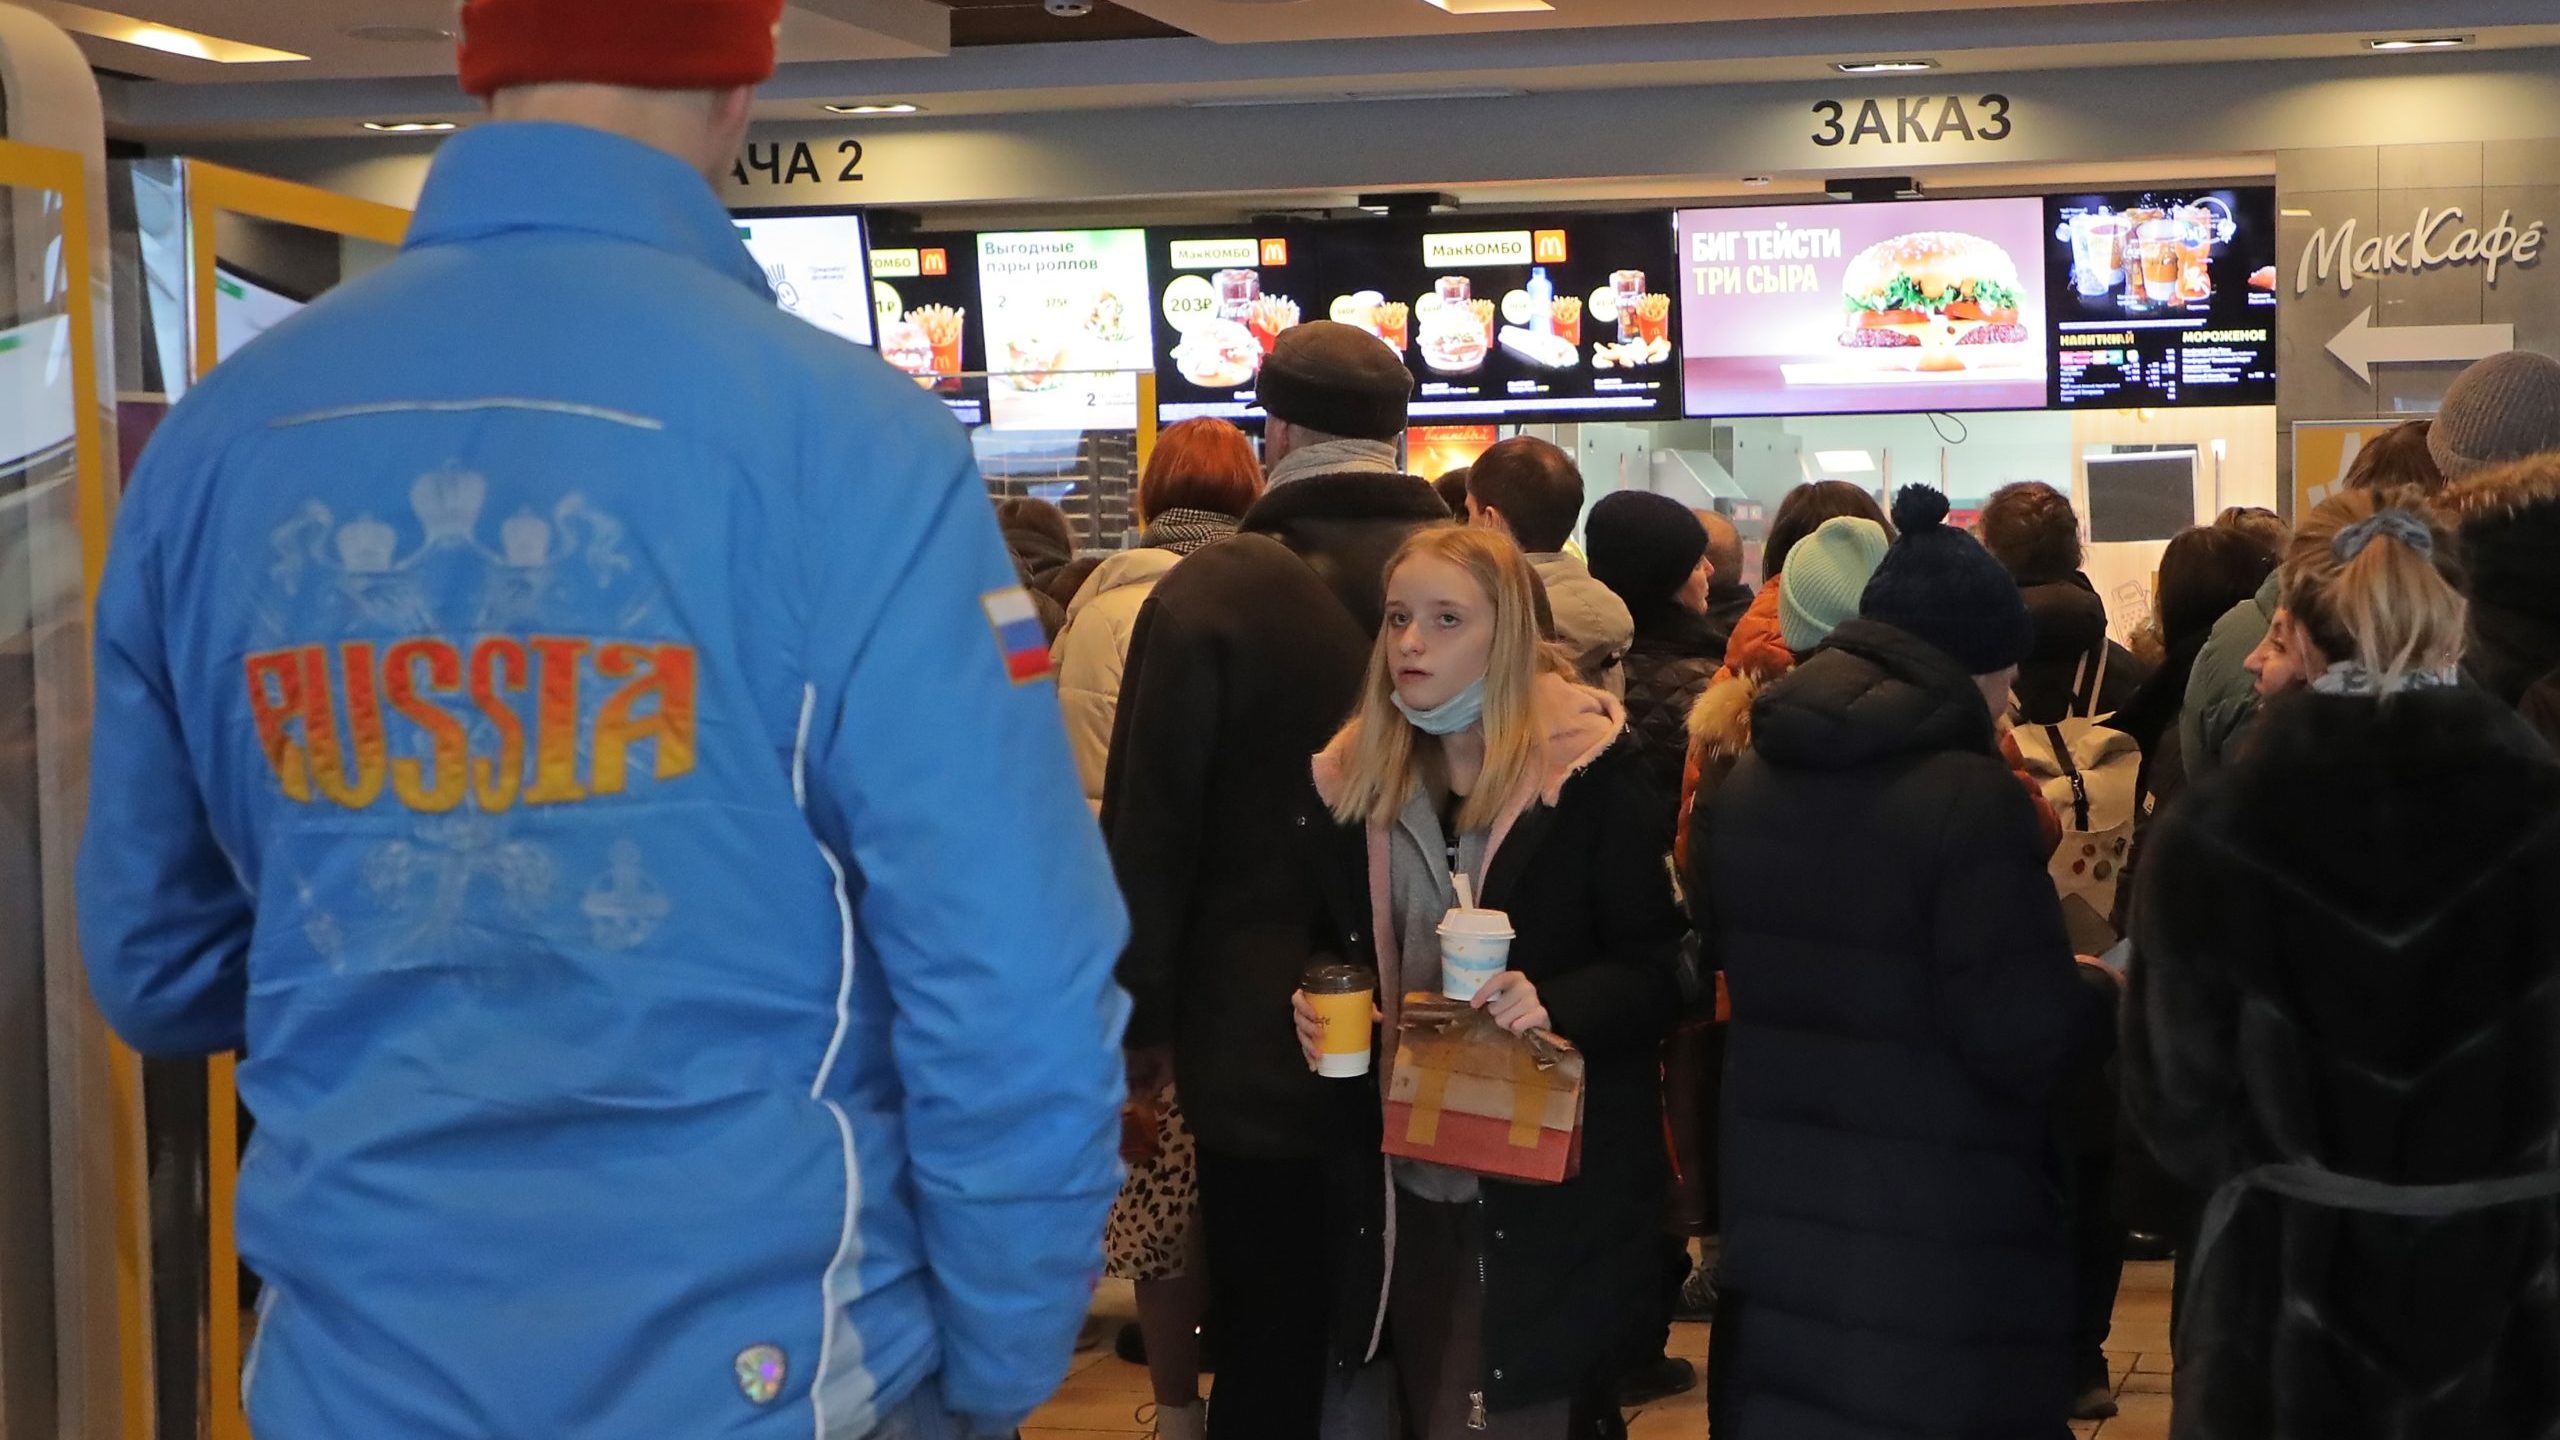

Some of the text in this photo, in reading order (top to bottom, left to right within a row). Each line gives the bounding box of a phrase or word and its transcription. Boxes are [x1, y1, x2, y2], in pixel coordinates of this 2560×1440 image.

[1811, 93, 2012, 146] ЗАКАЗ
[838, 140, 864, 182] 2
[984, 241, 1075, 256] Выгодные
[1432, 241, 1523, 258] МакКОМБО
[1691, 221, 1842, 262] БИГ ТЕЙСТИ
[1178, 248, 1251, 260] МакКОМБО
[871, 257, 912, 269] ОМБО
[986, 259, 1099, 275] пары роллов
[1692, 264, 1820, 297] ТРИ СЫРА
[2182, 329, 2267, 343] МОРОЖЕНОЕ
[244, 634, 697, 814] RUSSIA
